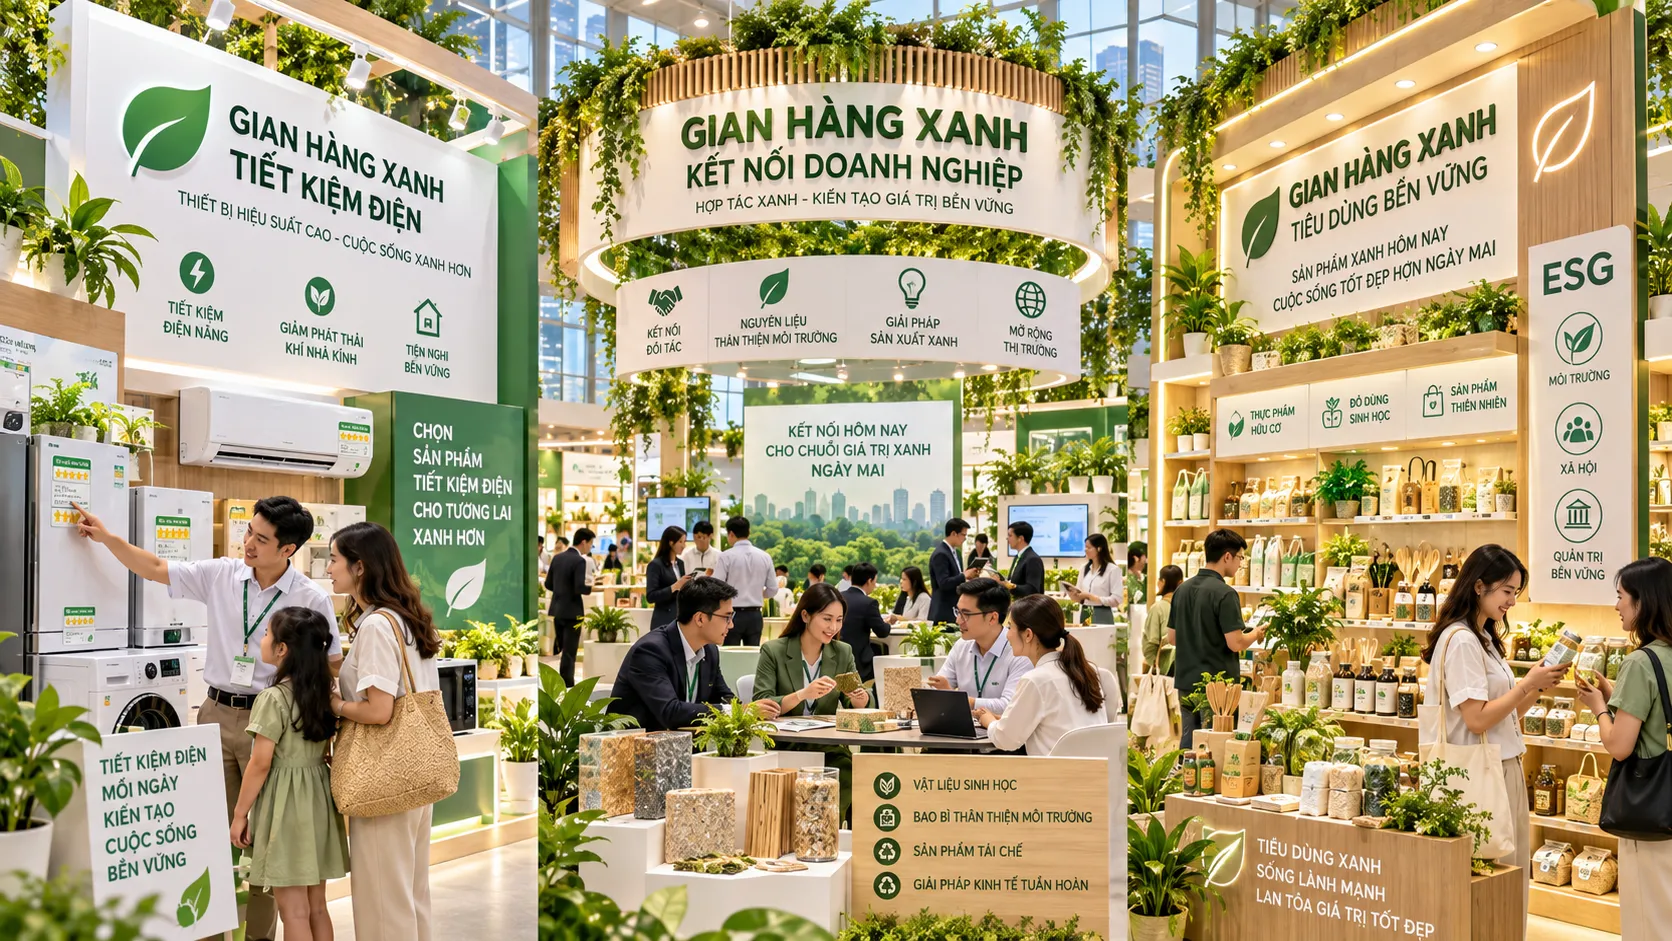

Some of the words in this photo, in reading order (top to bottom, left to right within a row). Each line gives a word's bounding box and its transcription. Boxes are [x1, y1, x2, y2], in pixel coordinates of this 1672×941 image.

[681, 108, 772, 150] GIAN
[788, 95, 903, 140] HÀNG
[916, 107, 1028, 152] XANH
[230, 105, 297, 151] GIAN
[306, 131, 375, 178] HÀNG
[382, 159, 444, 203] XANH
[1289, 167, 1338, 208] GIAN
[1344, 140, 1410, 188] HÀNG
[1418, 104, 1496, 162] XANH
[687, 152, 734, 189] KẾT
[744, 146, 793, 184] NỐI
[805, 153, 911, 179] DOANH
[922, 156, 1023, 193] NGHIỆP
[230, 149, 293, 193] TIẾT
[302, 172, 361, 215] KIỆM
[369, 195, 421, 233] ĐIỆN
[758, 194, 797, 207] XANH
[1292, 213, 1324, 242] TIÊU
[1329, 194, 1378, 230] DÙNG
[1427, 156, 1487, 196] VỮNG
[178, 190, 217, 213] THIẾT
[237, 205, 266, 227] HIỆU
[306, 225, 331, 242] CAO
[343, 235, 376, 255] CUỘC
[415, 253, 445, 271] XANH
[1351, 244, 1384, 267] XANH
[1388, 234, 1417, 256] HÔM
[1422, 225, 1448, 247] NAY
[1273, 291, 1302, 312] CUỘC
[1340, 273, 1362, 294] TỐT
[1366, 269, 1389, 290] ĐẸP
[1426, 244, 1464, 272] NGÀY
[1469, 240, 1496, 262] MAI
[1544, 252, 1613, 295] ESG
[428, 348, 448, 361] NGHI
[928, 334, 958, 347] XANH
[413, 422, 452, 443] CHỌN
[881, 424, 907, 436] NAY
[1350, 413, 1369, 424] SINH
[414, 444, 441, 465] SẢN
[766, 445, 794, 457] CHO
[894, 444, 930, 455] XANH
[413, 470, 443, 491] TIẾT
[447, 473, 478, 496] KIỆM
[482, 475, 512, 498] ĐIỆN
[857, 464, 884, 477] MAI
[413, 502, 442, 518] CHO
[493, 505, 511, 520] LAI
[413, 528, 452, 544] XANH
[100, 752, 131, 774] TIẾT
[137, 750, 171, 771] KIỆM
[175, 746, 206, 766] ĐIỆN
[964, 780, 989, 790] SINH
[144, 802, 174, 822] TẠO
[914, 811, 937, 822] BAO
[106, 830, 151, 854] CUỘC
[156, 822, 196, 845] SỐNG
[1292, 843, 1334, 866] DÙNG
[1339, 853, 1381, 874] XANH
[974, 880, 1000, 890] KINH
[1257, 860, 1294, 883] SỐNG
[1299, 870, 1336, 892] LÀNH
[1341, 880, 1385, 902] MẠNH
[1257, 889, 1281, 906] LAN
[1317, 900, 1340, 920] GIÁ
[1371, 910, 1400, 931] TỐT
[1404, 919, 1434, 940] ĐẸP
